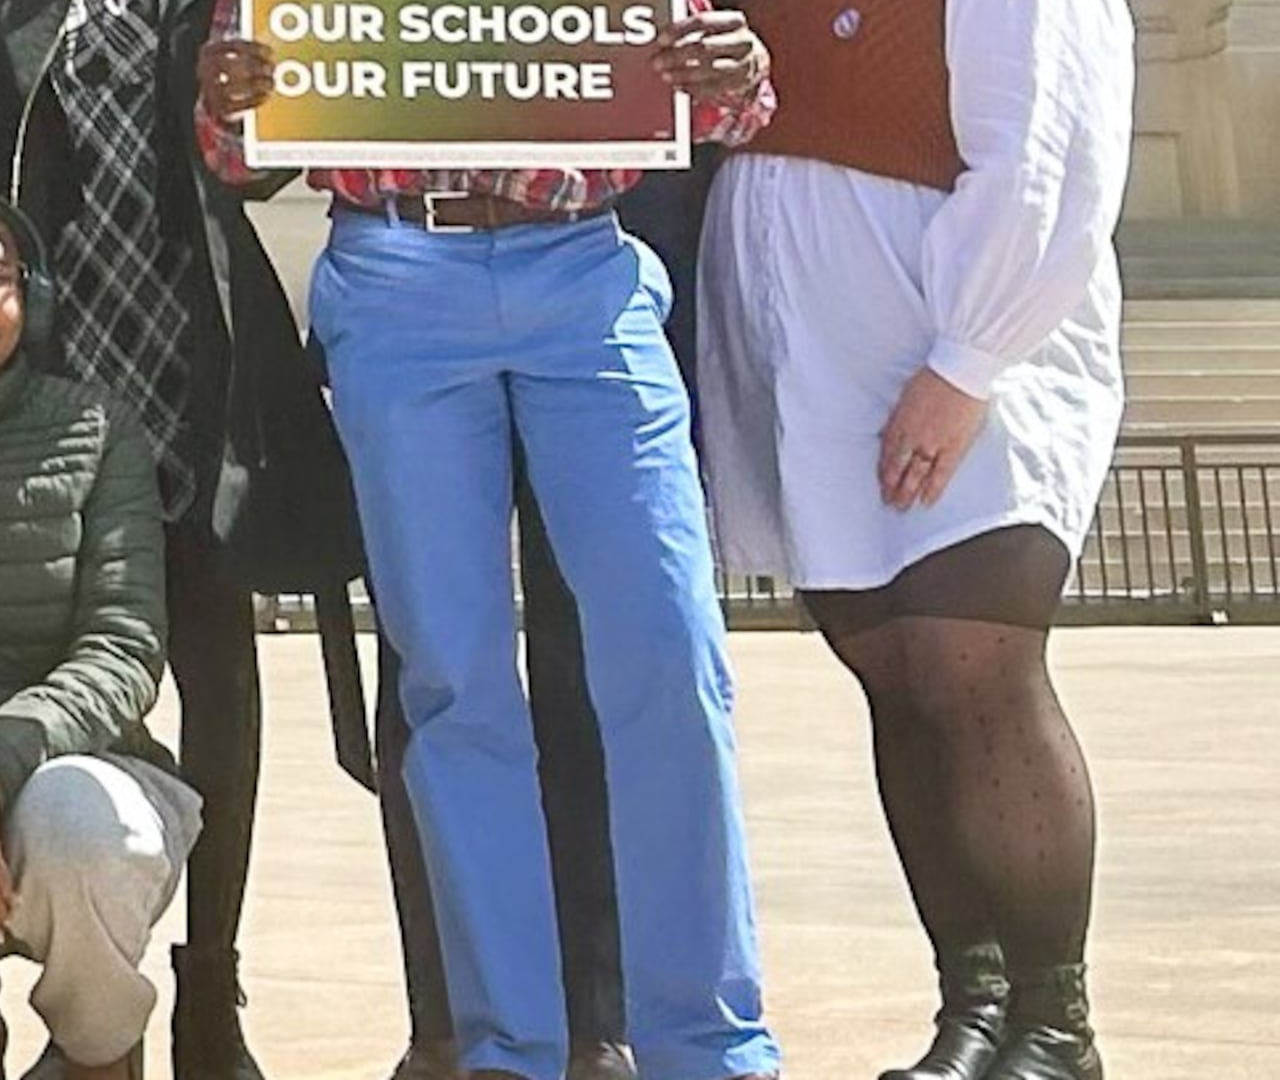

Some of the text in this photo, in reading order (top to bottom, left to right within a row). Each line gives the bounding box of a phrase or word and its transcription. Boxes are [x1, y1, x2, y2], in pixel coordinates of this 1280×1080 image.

[268, 2, 656, 45] OUR SCHOOLS
[271, 60, 614, 100] OUR FUTURE
